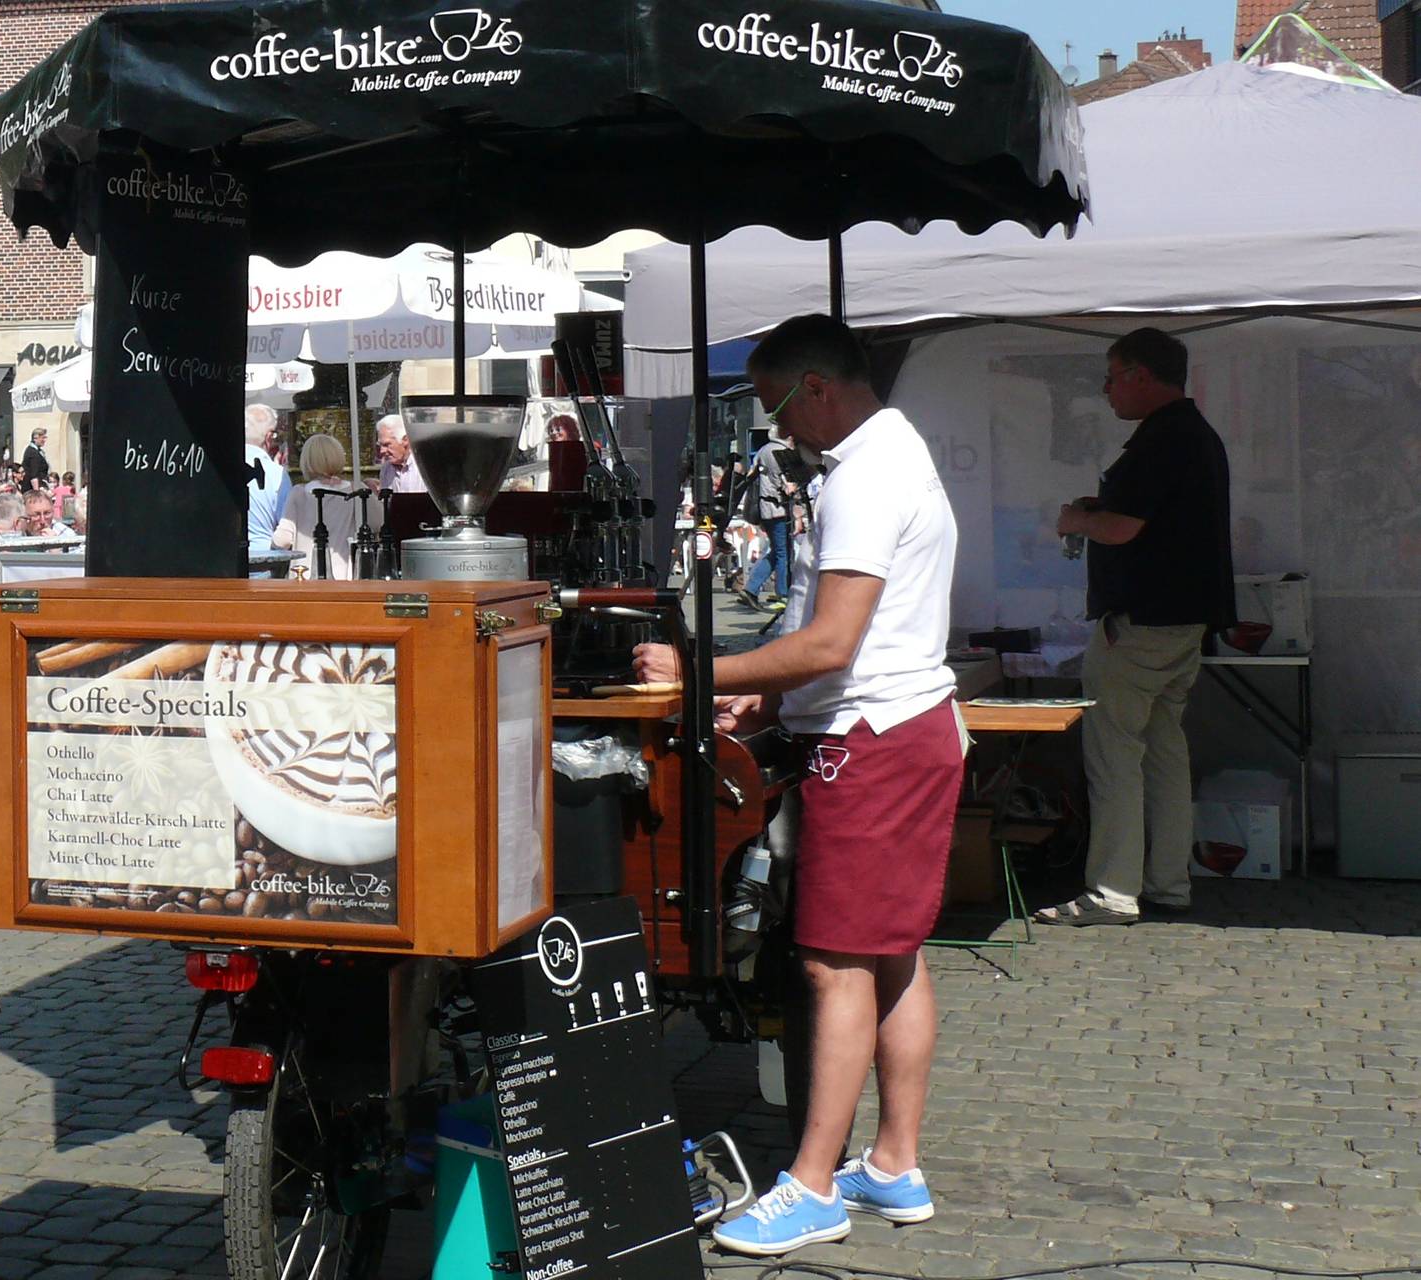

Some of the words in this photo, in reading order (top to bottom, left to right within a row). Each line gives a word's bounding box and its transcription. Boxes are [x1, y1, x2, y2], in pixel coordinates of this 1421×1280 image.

[210, 25, 418, 81] coffee-bike
[698, 13, 881, 76] coffee-bike
[351, 74, 401, 93] Mobile
[403, 70, 449, 92] Coffee
[451, 67, 522, 86] Company
[821, 75, 866, 96] Mobile
[866, 83, 903, 104] Coffee
[903, 90, 956, 117] Company
[107, 168, 205, 205] coffee-bike
[130, 274, 182, 312] Kurze
[426, 276, 546, 312] Beediktiner
[124, 439, 148, 470] bis
[153, 439, 206, 478] 16:10
[47, 686, 248, 725] Coffee-Specials
[46, 745, 95, 760] Othello
[46, 766, 124, 783] Mochaccino
[46, 787, 77, 802] Chai
[80, 789, 114, 804] Latte
[47, 809, 188, 829] Schwarzwälder-Kirsch
[191, 815, 227, 830] Latte
[47, 829, 144, 848] Karamell-Choc
[147, 835, 182, 850] Latte
[47, 850, 119, 867] Mint-Choc
[121, 854, 156, 869] Latte
[250, 872, 346, 896] coffee-bike
[337, 899, 359, 909] Coffee
[358, 900, 390, 911] Company
[486, 1032, 519, 1049] Classics
[523, 1054, 554, 1069] macchiato
[496, 1076, 525, 1092] Espresso
[525, 1069, 548, 1084] doppio
[501, 1100, 538, 1118] Cappuccino
[503, 1116, 527, 1131] Othello
[505, 1127, 544, 1145] Mochaccino
[507, 1148, 541, 1169] Specials
[512, 1167, 549, 1186] Milchkaffee
[515, 1186, 532, 1200] Latte
[532, 1177, 564, 1193] macchiato
[517, 1196, 550, 1212] Mint-Choc
[549, 1189, 566, 1203] Latte
[519, 1204, 564, 1226] Karamell-Choc
[563, 1198, 581, 1212] Latte
[573, 1209, 590, 1223] Latte
[524, 1243, 542, 1258] Extra
[541, 1235, 570, 1252] Espresso
[569, 1229, 585, 1242] Shot
[526, 1257, 574, 1280] Non-Coffee
